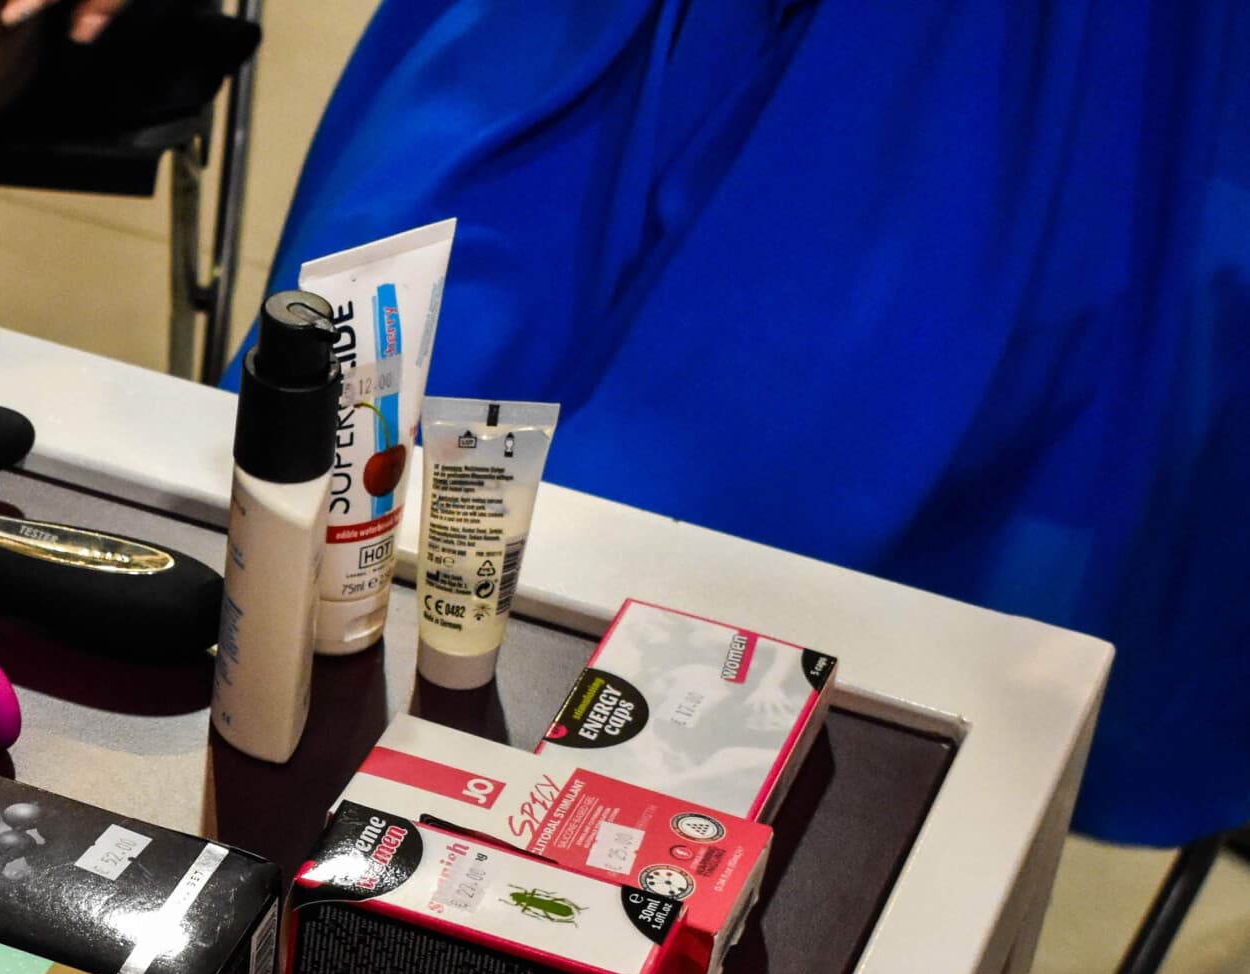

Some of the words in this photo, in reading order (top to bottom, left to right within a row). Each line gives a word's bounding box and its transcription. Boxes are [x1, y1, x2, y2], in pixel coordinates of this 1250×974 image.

[365, 542, 390, 563] HOT
[342, 582, 364, 594] 75ml
[445, 603, 466, 619] 0482
[719, 633, 749, 680] women
[578, 684, 623, 740] ENERGY
[604, 699, 636, 735] caps
[461, 774, 496, 805] JO
[553, 778, 586, 819] STIMULANT
[503, 774, 562, 841] SPICY
[100, 837, 136, 866] 52.00
[639, 897, 660, 922] 30ml
